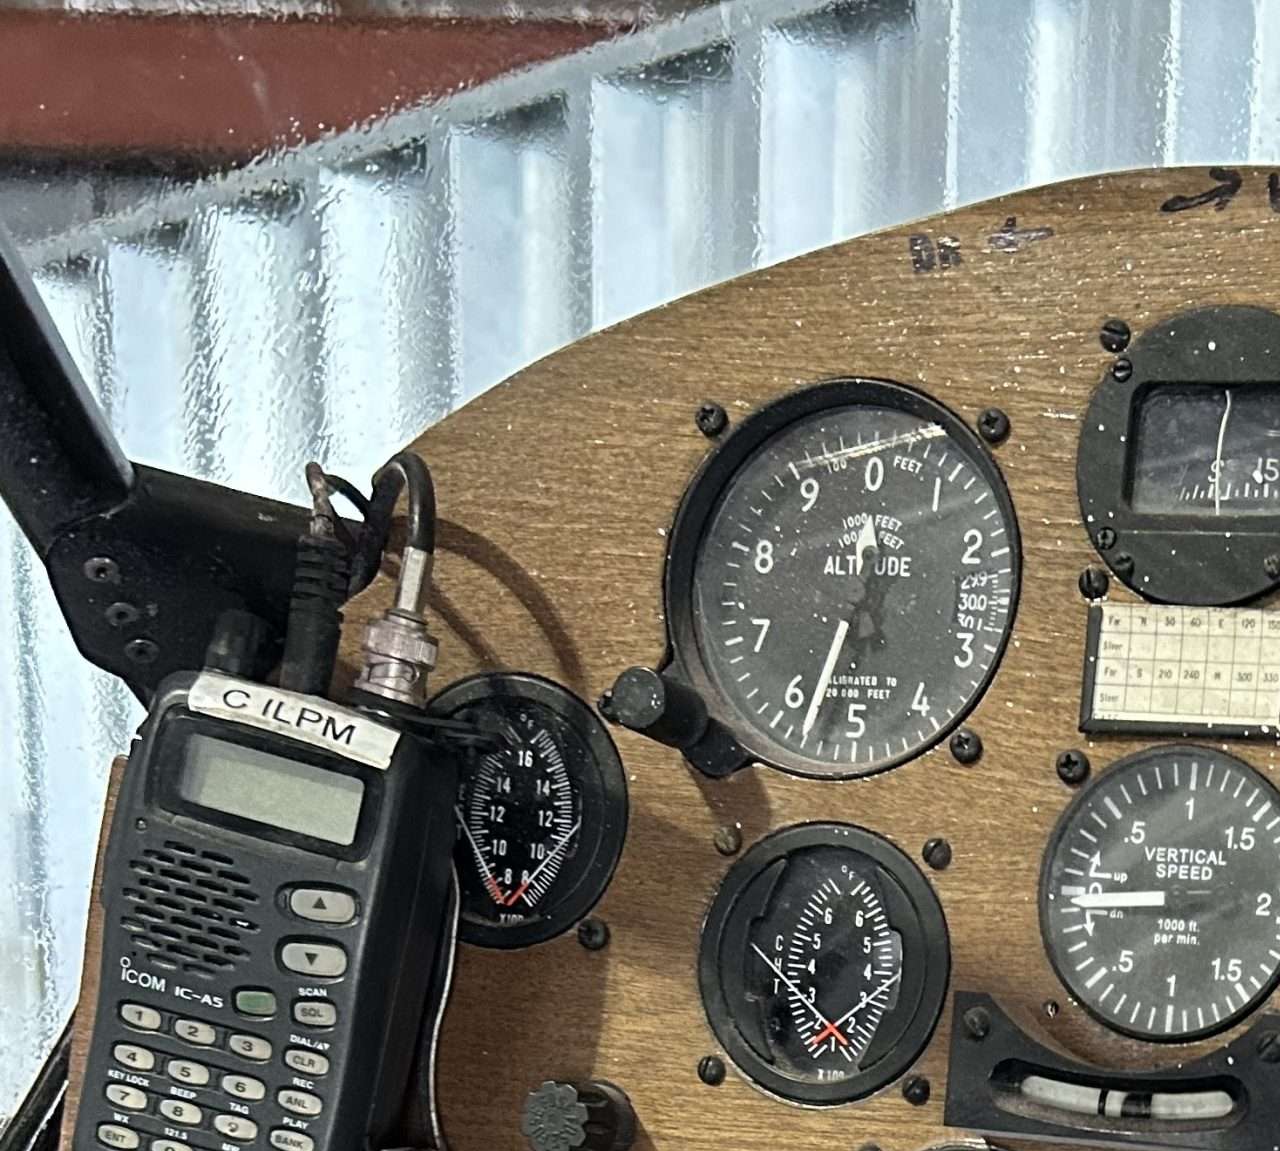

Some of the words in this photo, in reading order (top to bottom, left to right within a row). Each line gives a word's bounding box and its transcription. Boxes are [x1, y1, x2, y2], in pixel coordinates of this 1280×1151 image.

[893, 455, 923, 474] FEET
[865, 456, 884, 491] 0
[800, 478, 819, 512] 9
[932, 477, 941, 512] 1
[875, 514, 902, 532] FEET
[961, 529, 983, 564] 2
[754, 539, 774, 573] 8
[824, 555, 912, 577] ALTUDE
[751, 619, 770, 652] 7
[954, 633, 974, 668] 3
[785, 675, 804, 708] 6
[867, 689, 890, 699] FEET
[912, 682, 930, 716] 4
[223, 690, 250, 709] C
[262, 699, 357, 745] ILPM
[846, 704, 866, 738] 5
[518, 751, 533, 767] 16
[497, 777, 511, 793] 14
[536, 780, 550, 796] 14
[490, 806, 505, 823] 12
[1185, 797, 1194, 820] 1
[538, 810, 553, 828] 12
[1124, 822, 1145, 844] .5
[1224, 826, 1255, 850] 1.5
[492, 840, 507, 856] 10
[530, 843, 544, 859] 10
[1144, 847, 1227, 866] VERTICAL
[504, 868, 512, 884] 8
[1113, 872, 1128, 883] up
[1156, 864, 1212, 881] SPEED
[1256, 893, 1272, 916] 2
[824, 907, 832, 924] 6
[855, 911, 864, 927] 6
[1157, 919, 1185, 931] 1000
[813, 933, 821, 949] 5
[863, 936, 871, 953] 5
[1153, 933, 1173, 945] per
[807, 959, 816, 975] 4
[1112, 950, 1133, 972] .5
[864, 964, 872, 980] 4
[1212, 958, 1242, 982] 1.5
[298, 987, 327, 997] SCAN
[1166, 974, 1176, 997] 1
[175, 986, 223, 1008] IC-A5
[808, 988, 816, 1003] 3
[135, 1010, 143, 1021] 1
[301, 1007, 323, 1017] SQL
[188, 1026, 199, 1037] 2
[847, 1017, 856, 1033] 2
[241, 1041, 253, 1052] 3
[830, 1036, 836, 1052] 1
[127, 1052, 137, 1062] 4
[292, 1055, 315, 1067] CLR
[108, 1069, 125, 1082] KEY
[125, 1073, 150, 1087] LOCK
[180, 1067, 191, 1078] 5
[235, 1082, 246, 1093] 6
[292, 1078, 315, 1089] REC
[119, 1091, 131, 1101] 7
[286, 1096, 309, 1109] ANL
[173, 1106, 183, 1117] 8
[229, 1103, 249, 1115] TAG
[227, 1122, 239, 1133] 9
[283, 1117, 309, 1130] PLAY
[105, 1132, 127, 1143] ENT
[274, 1135, 304, 1148] BANK
